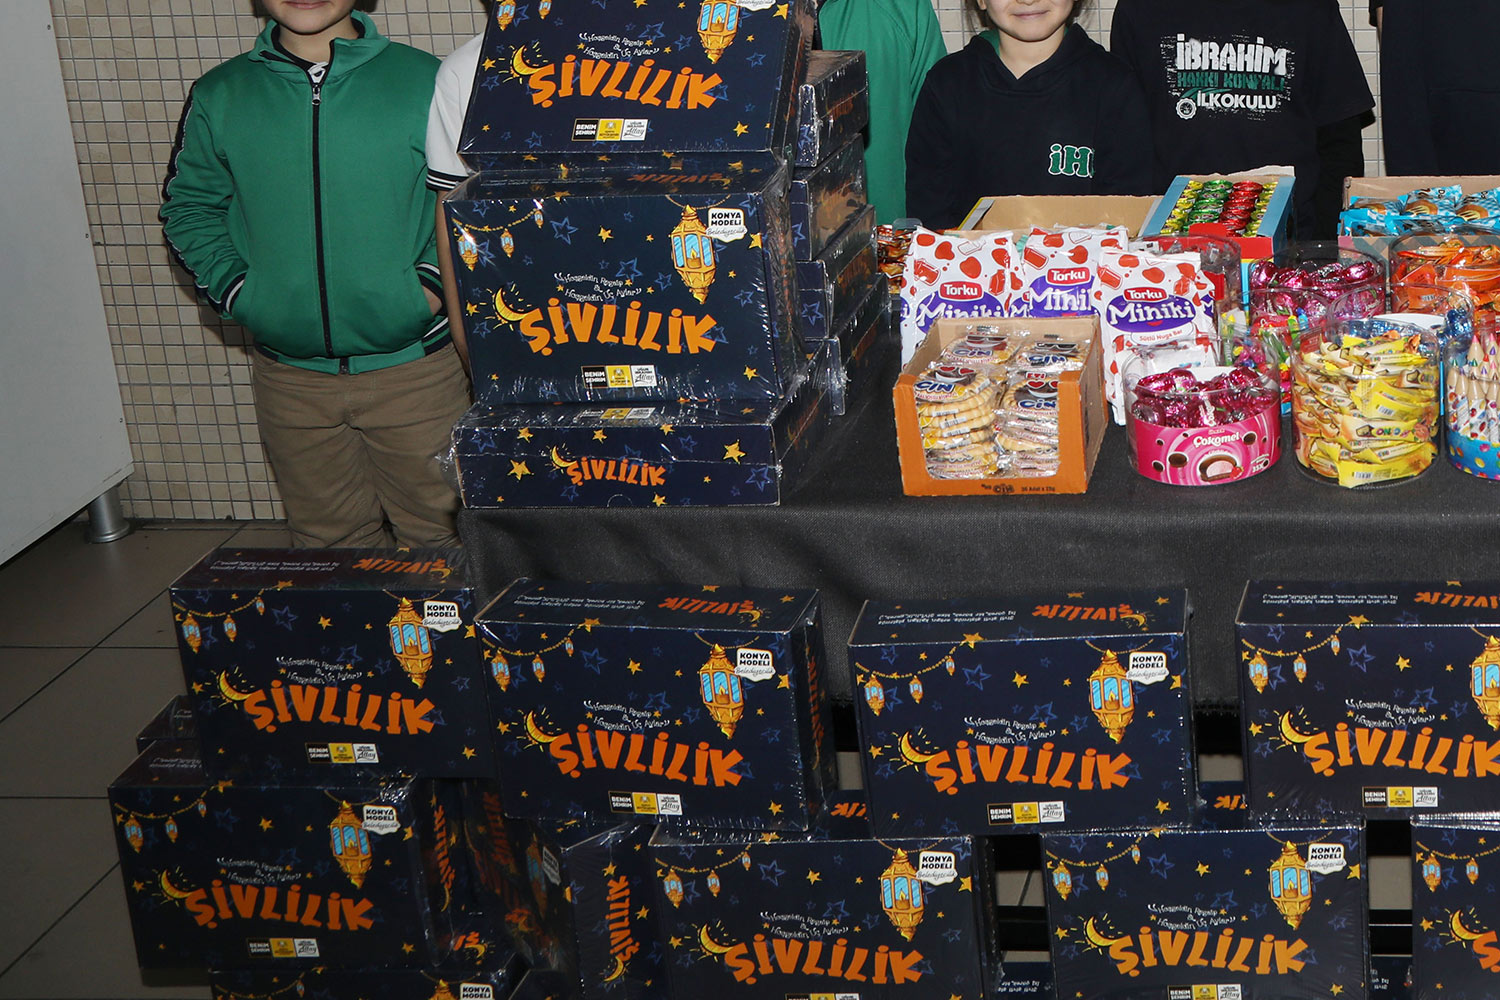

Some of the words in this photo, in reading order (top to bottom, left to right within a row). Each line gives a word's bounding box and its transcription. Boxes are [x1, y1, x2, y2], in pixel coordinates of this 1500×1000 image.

[1176, 33, 1287, 75] İBRAHİM
[528, 55, 724, 109] ŞİVLİLİK
[1197, 90, 1277, 109] İLKOKULU
[943, 283, 979, 297] Torku
[1050, 270, 1086, 282] Torku
[1126, 289, 1164, 301] Torku
[520, 298, 717, 356] ŞİVLİLİK
[1107, 302, 1195, 326] Miniki
[1156, 333, 1173, 341] Nuga
[1173, 330, 1183, 338] Bar
[1193, 433, 1240, 449] Çokomel
[566, 457, 666, 487] ŞİVLİLİK
[244, 680, 437, 734] ŞİVLİLİK
[550, 724, 744, 787] ŞİVLİLİK
[925, 740, 1134, 795] ŞİVLİLİK
[185, 880, 375, 931] ŞİVLİLİK
[724, 934, 924, 985] ŞİVLİLİK
[1109, 926, 1308, 977] ŞİVLİLİK
